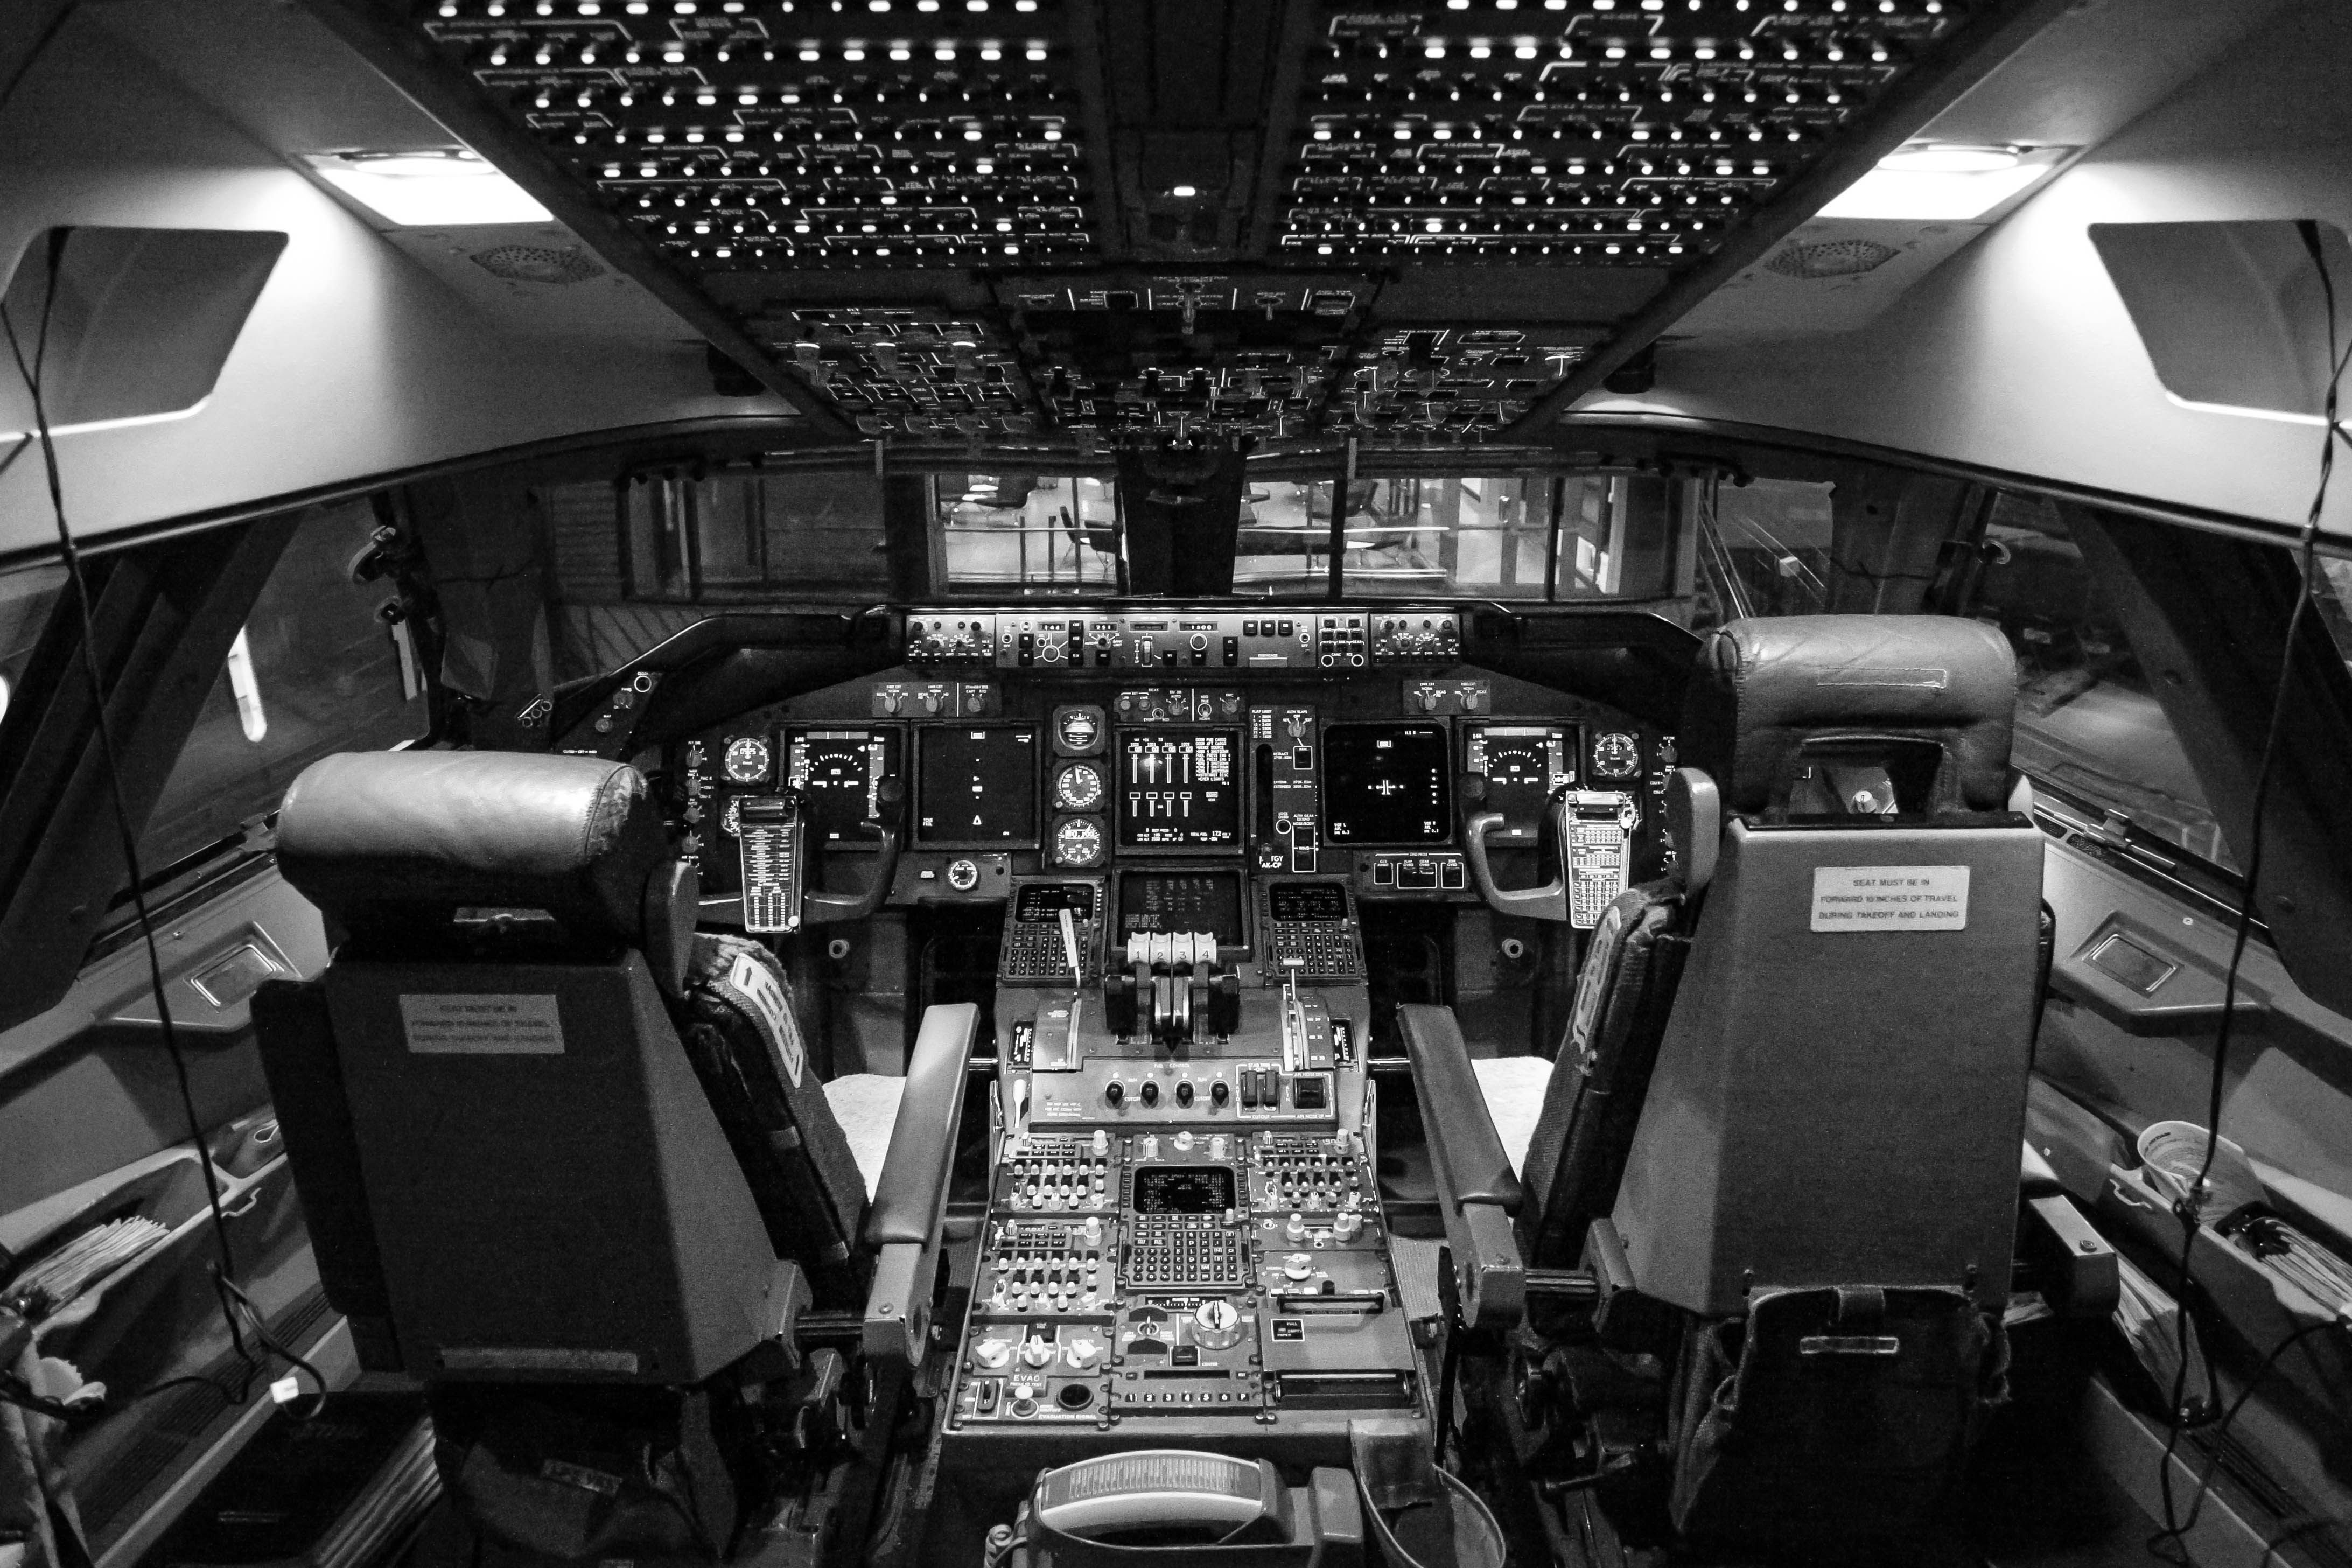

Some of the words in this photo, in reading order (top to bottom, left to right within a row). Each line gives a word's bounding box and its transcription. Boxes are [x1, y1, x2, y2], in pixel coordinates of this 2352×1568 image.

[1919, 910, 1959, 918] LANDING
[1136, 951, 1140, 959] 1
[1157, 951, 1164, 960] 2
[1179, 951, 1186, 960] 3
[1202, 950, 1209, 958] 4
